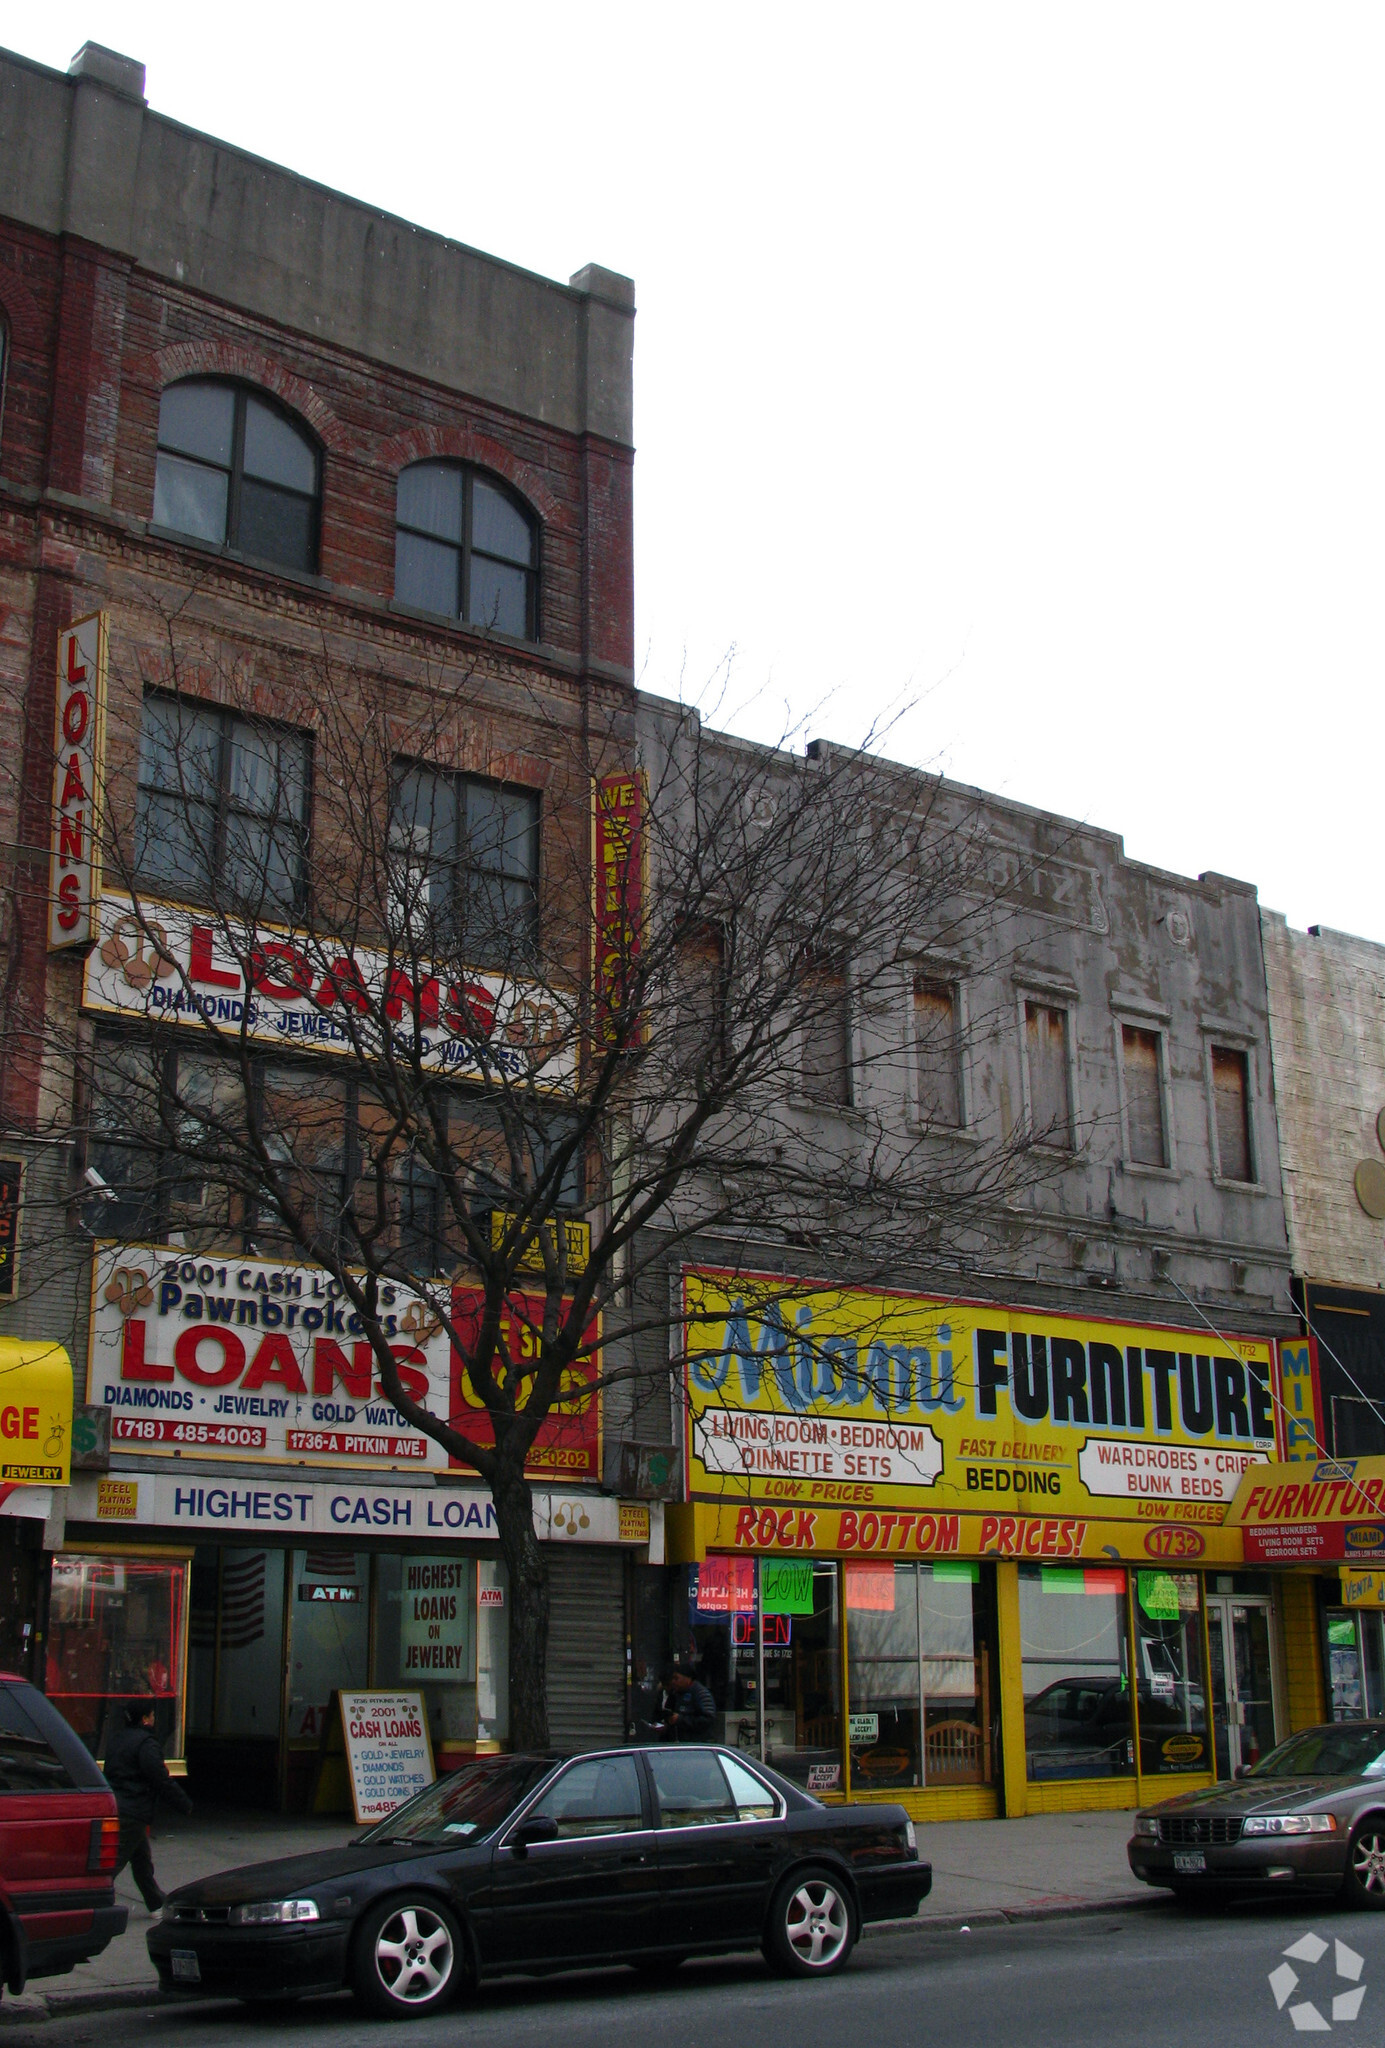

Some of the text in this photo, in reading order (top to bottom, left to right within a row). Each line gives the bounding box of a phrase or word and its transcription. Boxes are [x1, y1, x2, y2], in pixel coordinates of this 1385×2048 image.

[57, 635, 88, 929] LOANS
[599, 783, 635, 810] WE
[190, 924, 497, 1038] LOANS
[152, 986, 257, 1025] DIAMONDS
[162, 1261, 227, 1288] 2001
[238, 1268, 302, 1296] CASH
[121, 1319, 429, 1402] LOANS
[690, 1297, 966, 1415] Miami
[1239, 1344, 1256, 1357] 1732
[973, 1328, 1275, 1441] FURNITURE
[104, 1385, 193, 1411] DIAMONDS
[213, 1394, 289, 1418] JEWELRY
[312, 1403, 355, 1423] GOLD
[1, 1405, 39, 1440] GE
[116, 1418, 263, 1447] (718) 485-4003
[713, 1415, 924, 1451] LIVING ROOM BEDROOM
[290, 1432, 425, 1457] 1736-A PITKIN AVE.
[960, 1438, 1065, 1461] FAST DELIVERY
[1255, 1439, 1274, 1449] CORP.
[742, 1448, 892, 1477] DINNETTE SETS
[1097, 1445, 1197, 1471] WARDROBES
[4, 1467, 60, 1479] JEWELRY
[966, 1467, 1061, 1495] BEDDING
[1320, 1465, 1350, 1477] MIAMI
[100, 1483, 130, 1494] STEEL
[765, 1480, 875, 1501] LOW PRICES
[1127, 1473, 1224, 1498] BUNK BEDS
[99, 1506, 137, 1516] FIRST FLOOR
[175, 1488, 313, 1521] HIGHEST
[330, 1495, 412, 1526] CASH
[622, 1509, 644, 1519] STEEL
[1138, 1502, 1224, 1521] LOW PRICES
[734, 1506, 1088, 1558] ROCK BOTTOM PRICES!
[1154, 1529, 1198, 1555] 1732
[1249, 1528, 1279, 1537] BEDDING
[1258, 1536, 1324, 1547] LIVING ROOM SETS
[1350, 1532, 1381, 1544] MIAMI
[1300, 1547, 1318, 1555] SETS
[408, 1564, 462, 1590] HIGHEST
[763, 1561, 814, 1602] LOW
[312, 1587, 357, 1601] ATM
[481, 1591, 502, 1601] ATM
[1344, 1573, 1373, 1604] VENTA
[414, 1596, 457, 1621] LOANS
[428, 1625, 440, 1640] ON
[405, 1645, 462, 1669] JEWELRY
[371, 1707, 397, 1717] 2001
[857, 1717, 874, 1725] GLADLY
[350, 1719, 422, 1739] CASH LOANS
[855, 1725, 872, 1733] ACCEPT
[361, 1749, 424, 1760] GOLD JEWELRY
[362, 1762, 404, 1772] DIAMONDS
[813, 1774, 833, 1782] ACCEPT
[818, 1765, 837, 1774] GLADLY
[363, 1773, 425, 1785] GOLD WATCHES
[364, 1787, 385, 1798] GOLD
